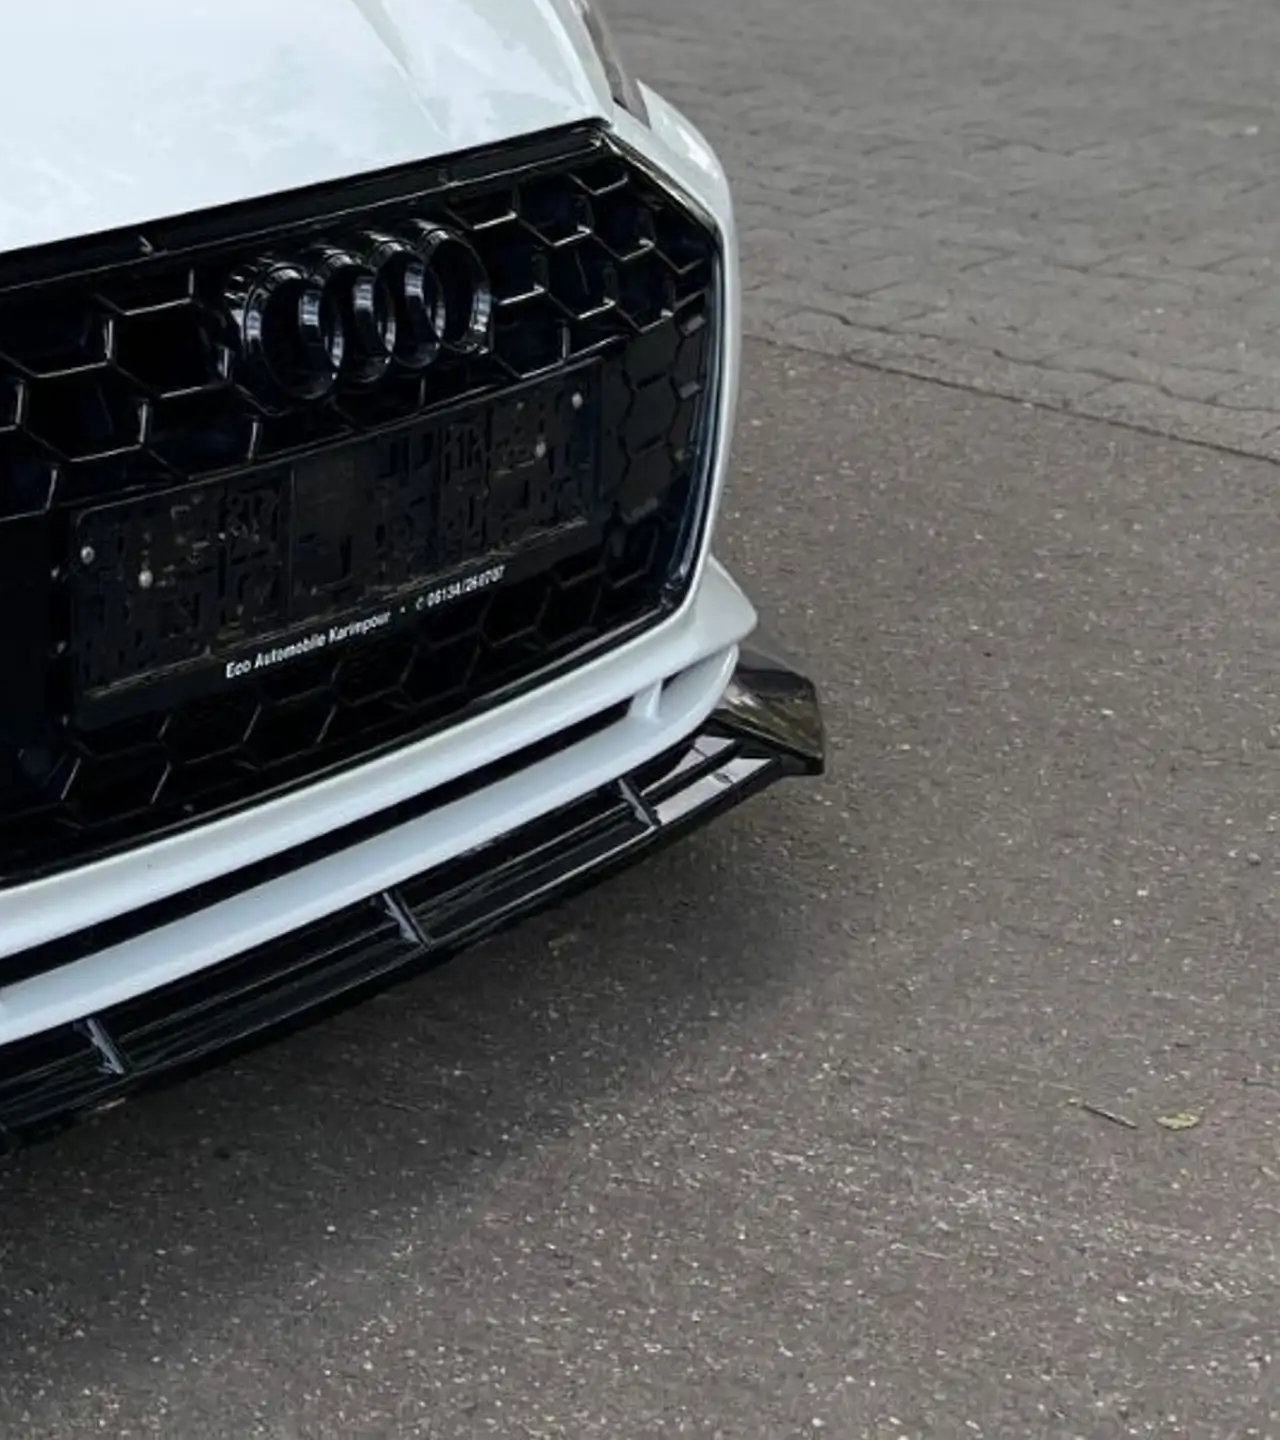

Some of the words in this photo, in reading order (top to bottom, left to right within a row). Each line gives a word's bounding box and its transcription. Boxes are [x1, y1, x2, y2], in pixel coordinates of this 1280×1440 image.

[225, 660, 252, 679] Eco
[253, 633, 327, 669] Automobile
[328, 611, 391, 644] Karimpour
